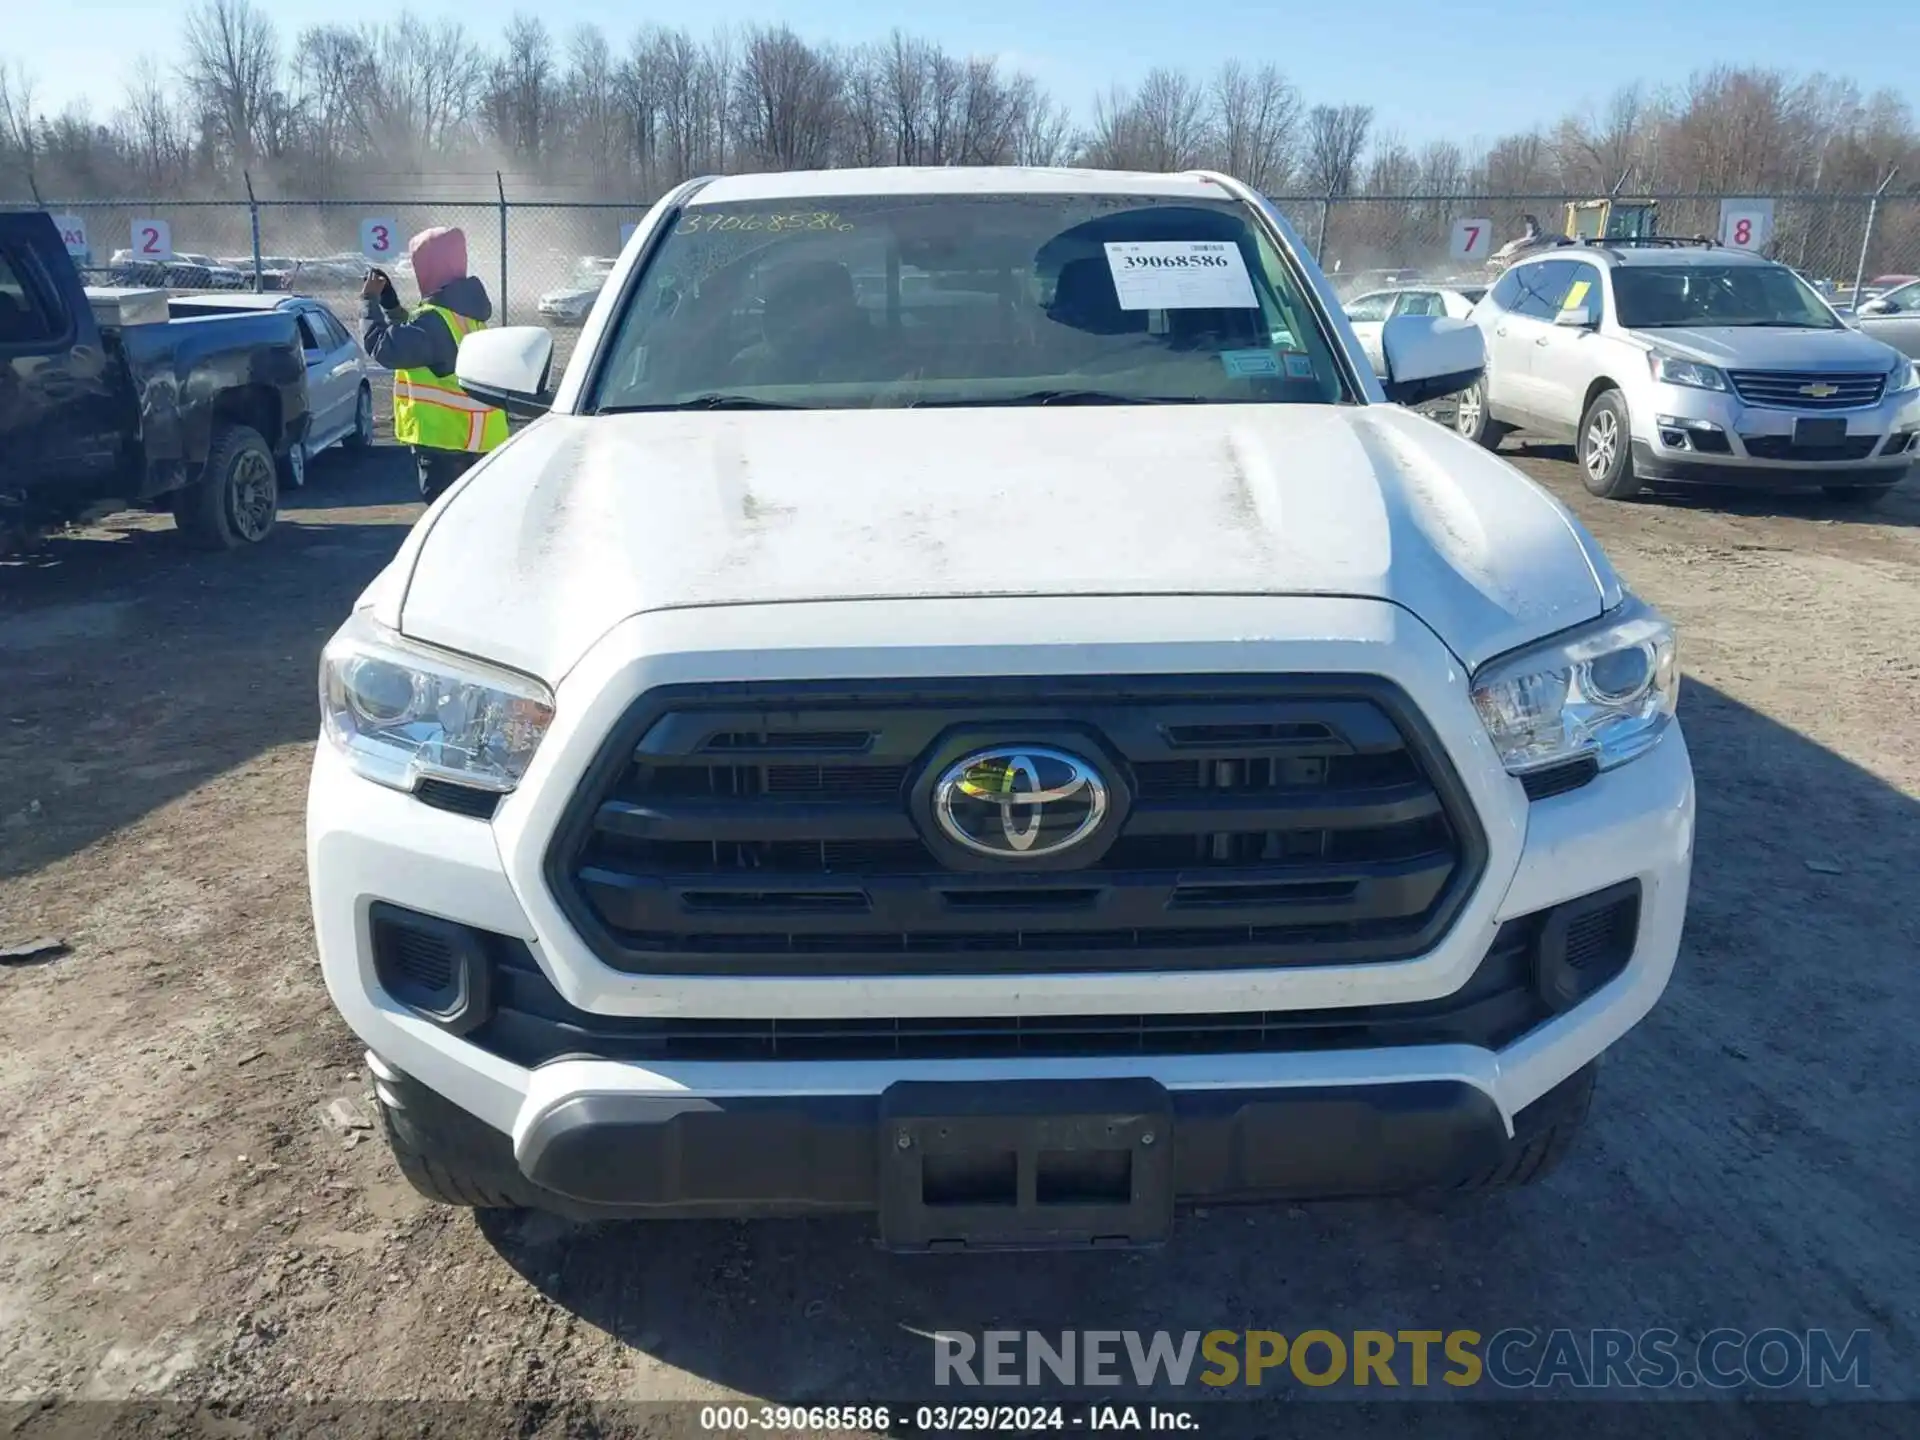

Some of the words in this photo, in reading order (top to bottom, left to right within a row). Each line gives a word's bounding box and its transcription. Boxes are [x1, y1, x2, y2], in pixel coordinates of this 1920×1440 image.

[675, 211, 854, 235] 39068586
[1734, 218, 1752, 245] 8
[141, 227, 162, 254] 2
[371, 225, 389, 251] 3
[1463, 226, 1480, 252] 7
[1123, 255, 1229, 270] 39068586
